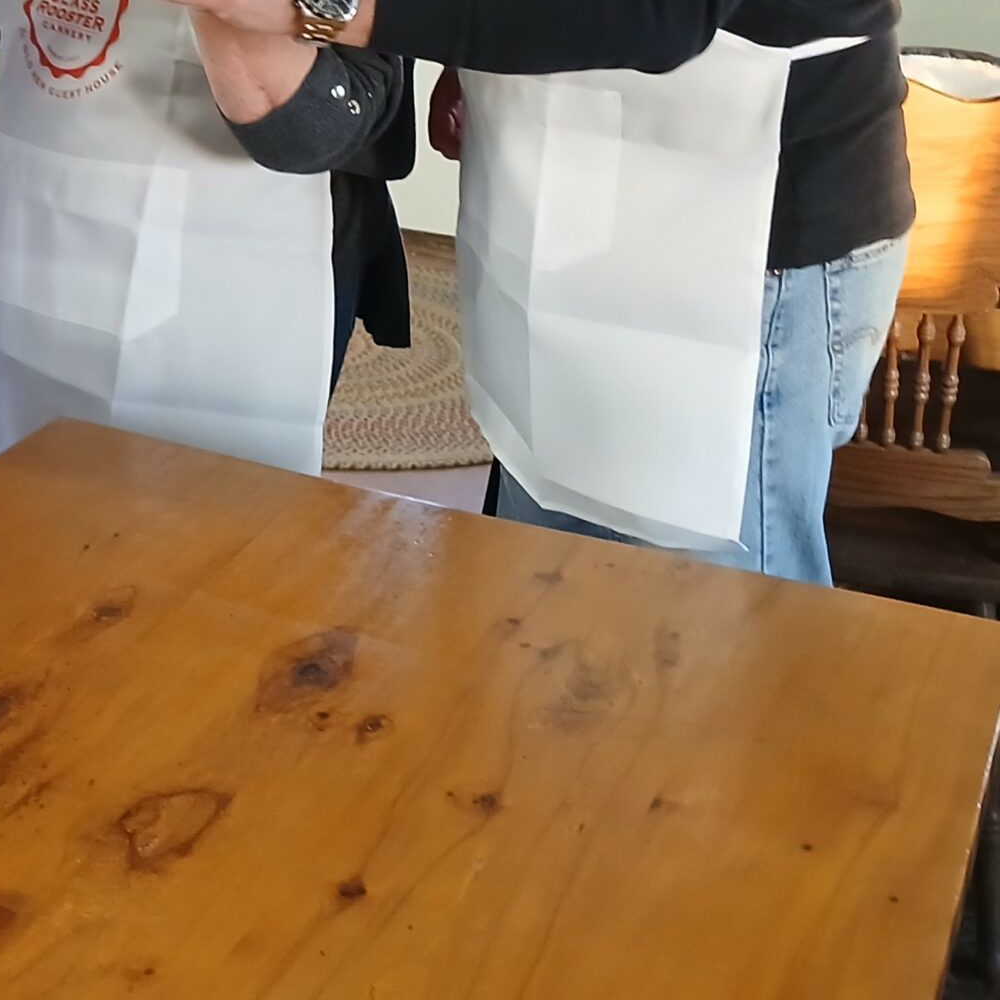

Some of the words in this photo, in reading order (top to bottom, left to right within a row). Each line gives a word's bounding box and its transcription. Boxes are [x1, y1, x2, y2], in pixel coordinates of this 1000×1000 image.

[36, 0, 105, 33] ROOSTER
[41, 19, 92, 43] CANNERY
[84, 58, 124, 94] HOUSE
